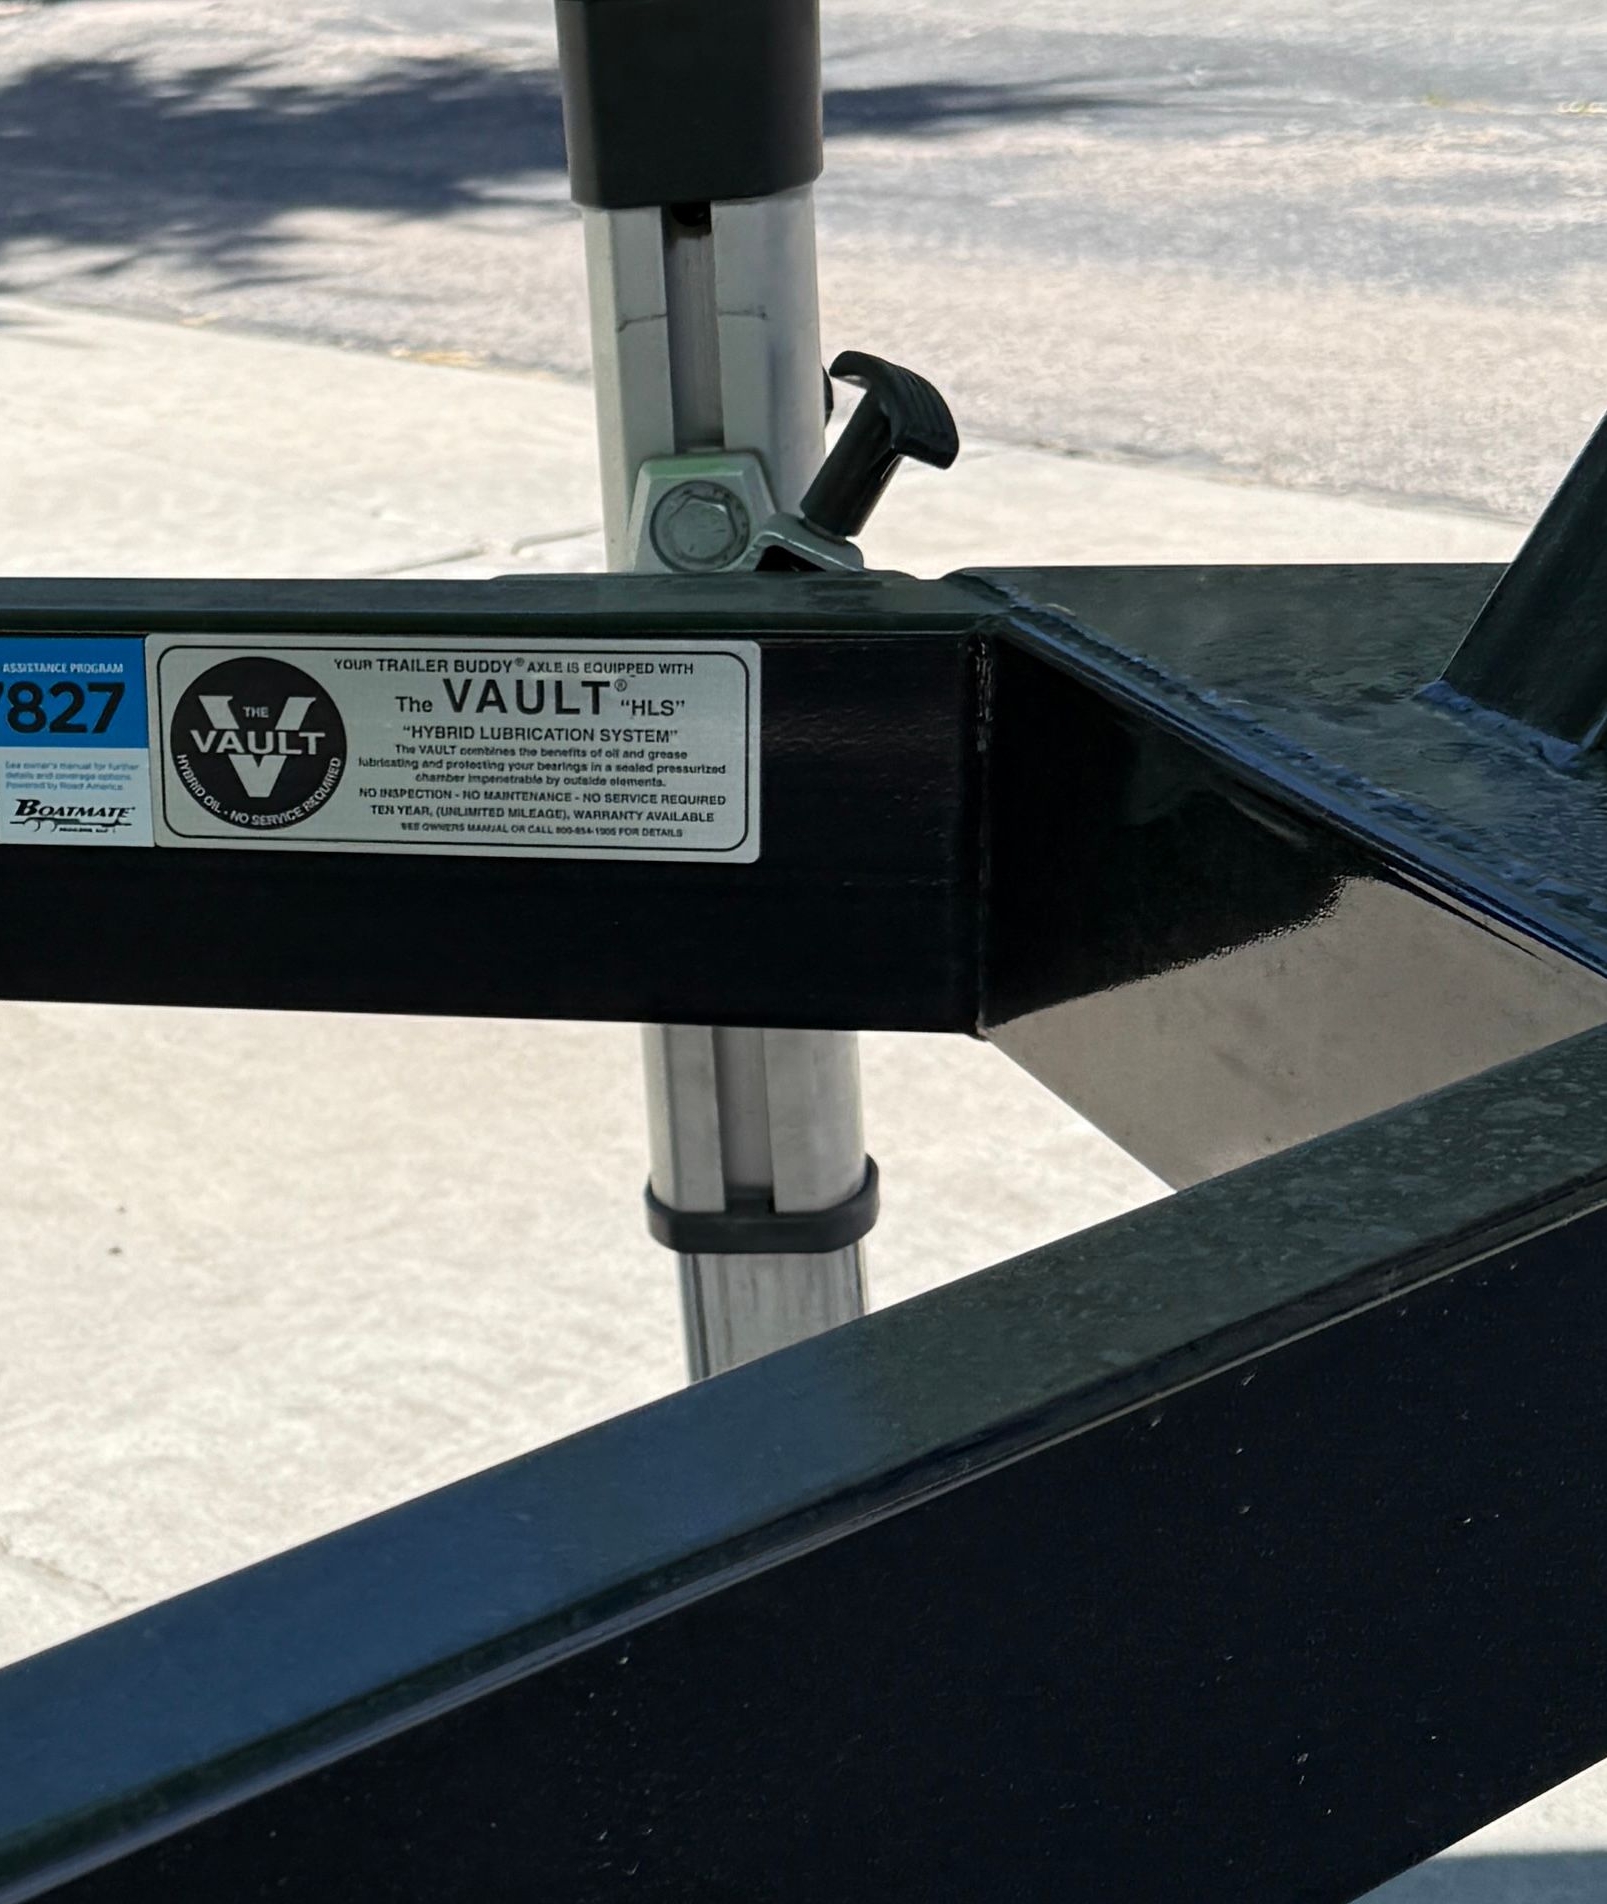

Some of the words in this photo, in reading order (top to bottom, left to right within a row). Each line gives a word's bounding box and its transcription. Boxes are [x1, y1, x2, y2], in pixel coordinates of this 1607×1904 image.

[2, 663, 68, 673] ASSISTANCE
[69, 663, 124, 674] PROGRAM
[334, 658, 374, 671] YOUR
[376, 658, 449, 674] TRAILER
[526, 661, 563, 674] AXLE
[566, 661, 580, 674] IS
[583, 661, 654, 675] EQUIPPED
[658, 662, 694, 676] WITH
[242, 706, 270, 719] THE
[395, 695, 435, 714] The
[189, 729, 326, 756] VAULT
[480, 726, 595, 743] LUBRICATION
[395, 744, 416, 755] The
[418, 745, 458, 756] VAULT
[459, 746, 516, 758] combines
[518, 747, 538, 758] the
[540, 747, 588, 759] benefits
[589, 748, 603, 759] of
[604, 749, 620, 760] oil
[622, 749, 645, 760] and
[647, 751, 688, 762] grease
[358, 756, 419, 770] lubricating
[421, 758, 444, 770] and
[446, 759, 505, 772] protecting
[507, 762, 536, 773] your
[537, 761, 588, 774] bearings
[590, 762, 603, 773] in
[604, 764, 613, 773] a
[614, 762, 654, 774] sealed
[656, 763, 727, 776] pressurized
[176, 753, 207, 798] HYBRID
[203, 794, 222, 815] OIL
[229, 809, 250, 825] NO
[250, 807, 306, 826] SERVICE
[301, 756, 343, 814] REQUIRED
[414, 773, 466, 784] chamber
[467, 774, 543, 786] impenetrable
[545, 775, 560, 788] by
[563, 776, 607, 787] outside
[358, 787, 377, 799] NO
[379, 788, 453, 800] INSPECTION
[462, 790, 481, 801] NO
[483, 790, 572, 803] MAINTENANCE
[582, 792, 601, 804] NO
[604, 793, 659, 805] SERVICE
[660, 794, 727, 806] REQUIRED
[370, 804, 396, 816] TEN
[435, 806, 505, 819] (UNLIMITED
[573, 810, 644, 822] WARRANTY
[645, 811, 715, 823] AVAILABLE
[421, 822, 466, 833] OWNERS
[467, 823, 509, 834] MANUAL
[510, 824, 526, 834] OR
[527, 824, 554, 835] CALL
[618, 827, 640, 837] FOR
[641, 827, 683, 838] DETAILS
